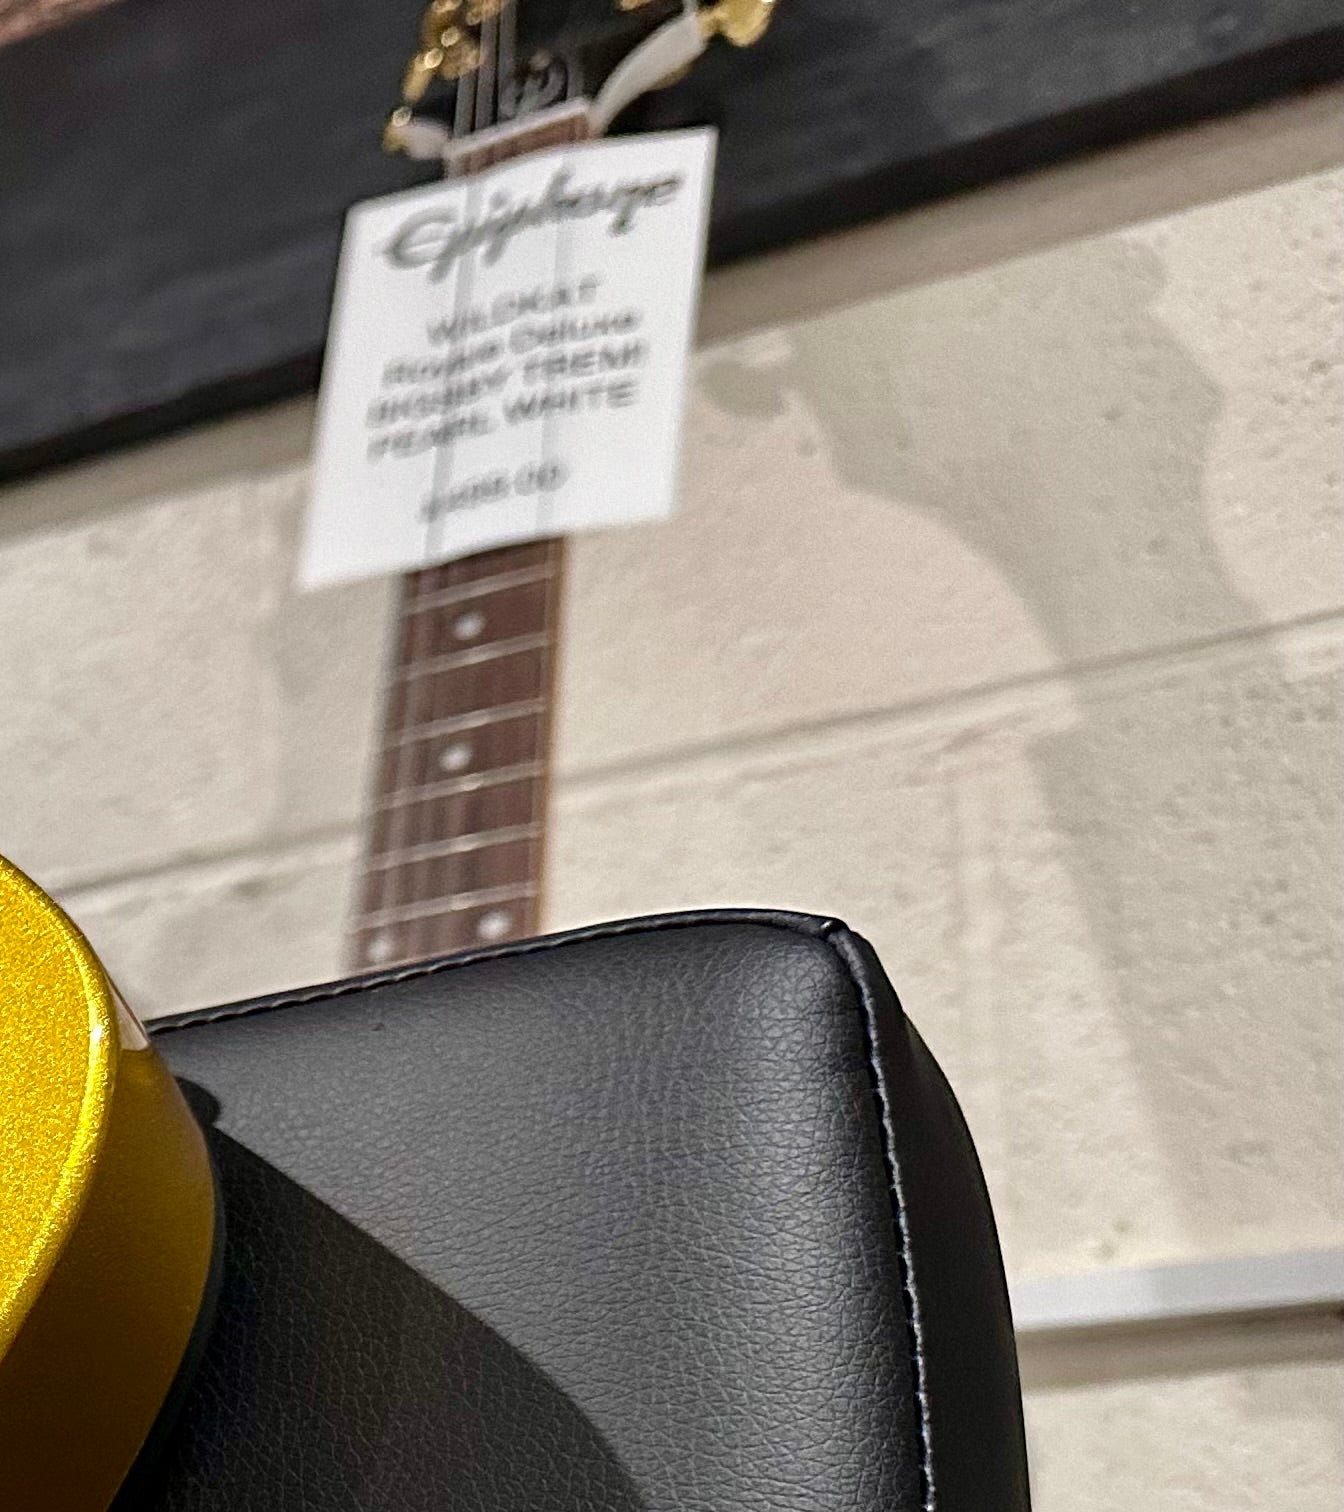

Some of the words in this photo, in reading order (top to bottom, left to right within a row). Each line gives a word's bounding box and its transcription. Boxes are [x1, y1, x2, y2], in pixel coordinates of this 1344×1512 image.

[382, 164, 686, 282] Epiphone
[427, 275, 600, 345] WILDKAT
[503, 376, 639, 425] WHITE
